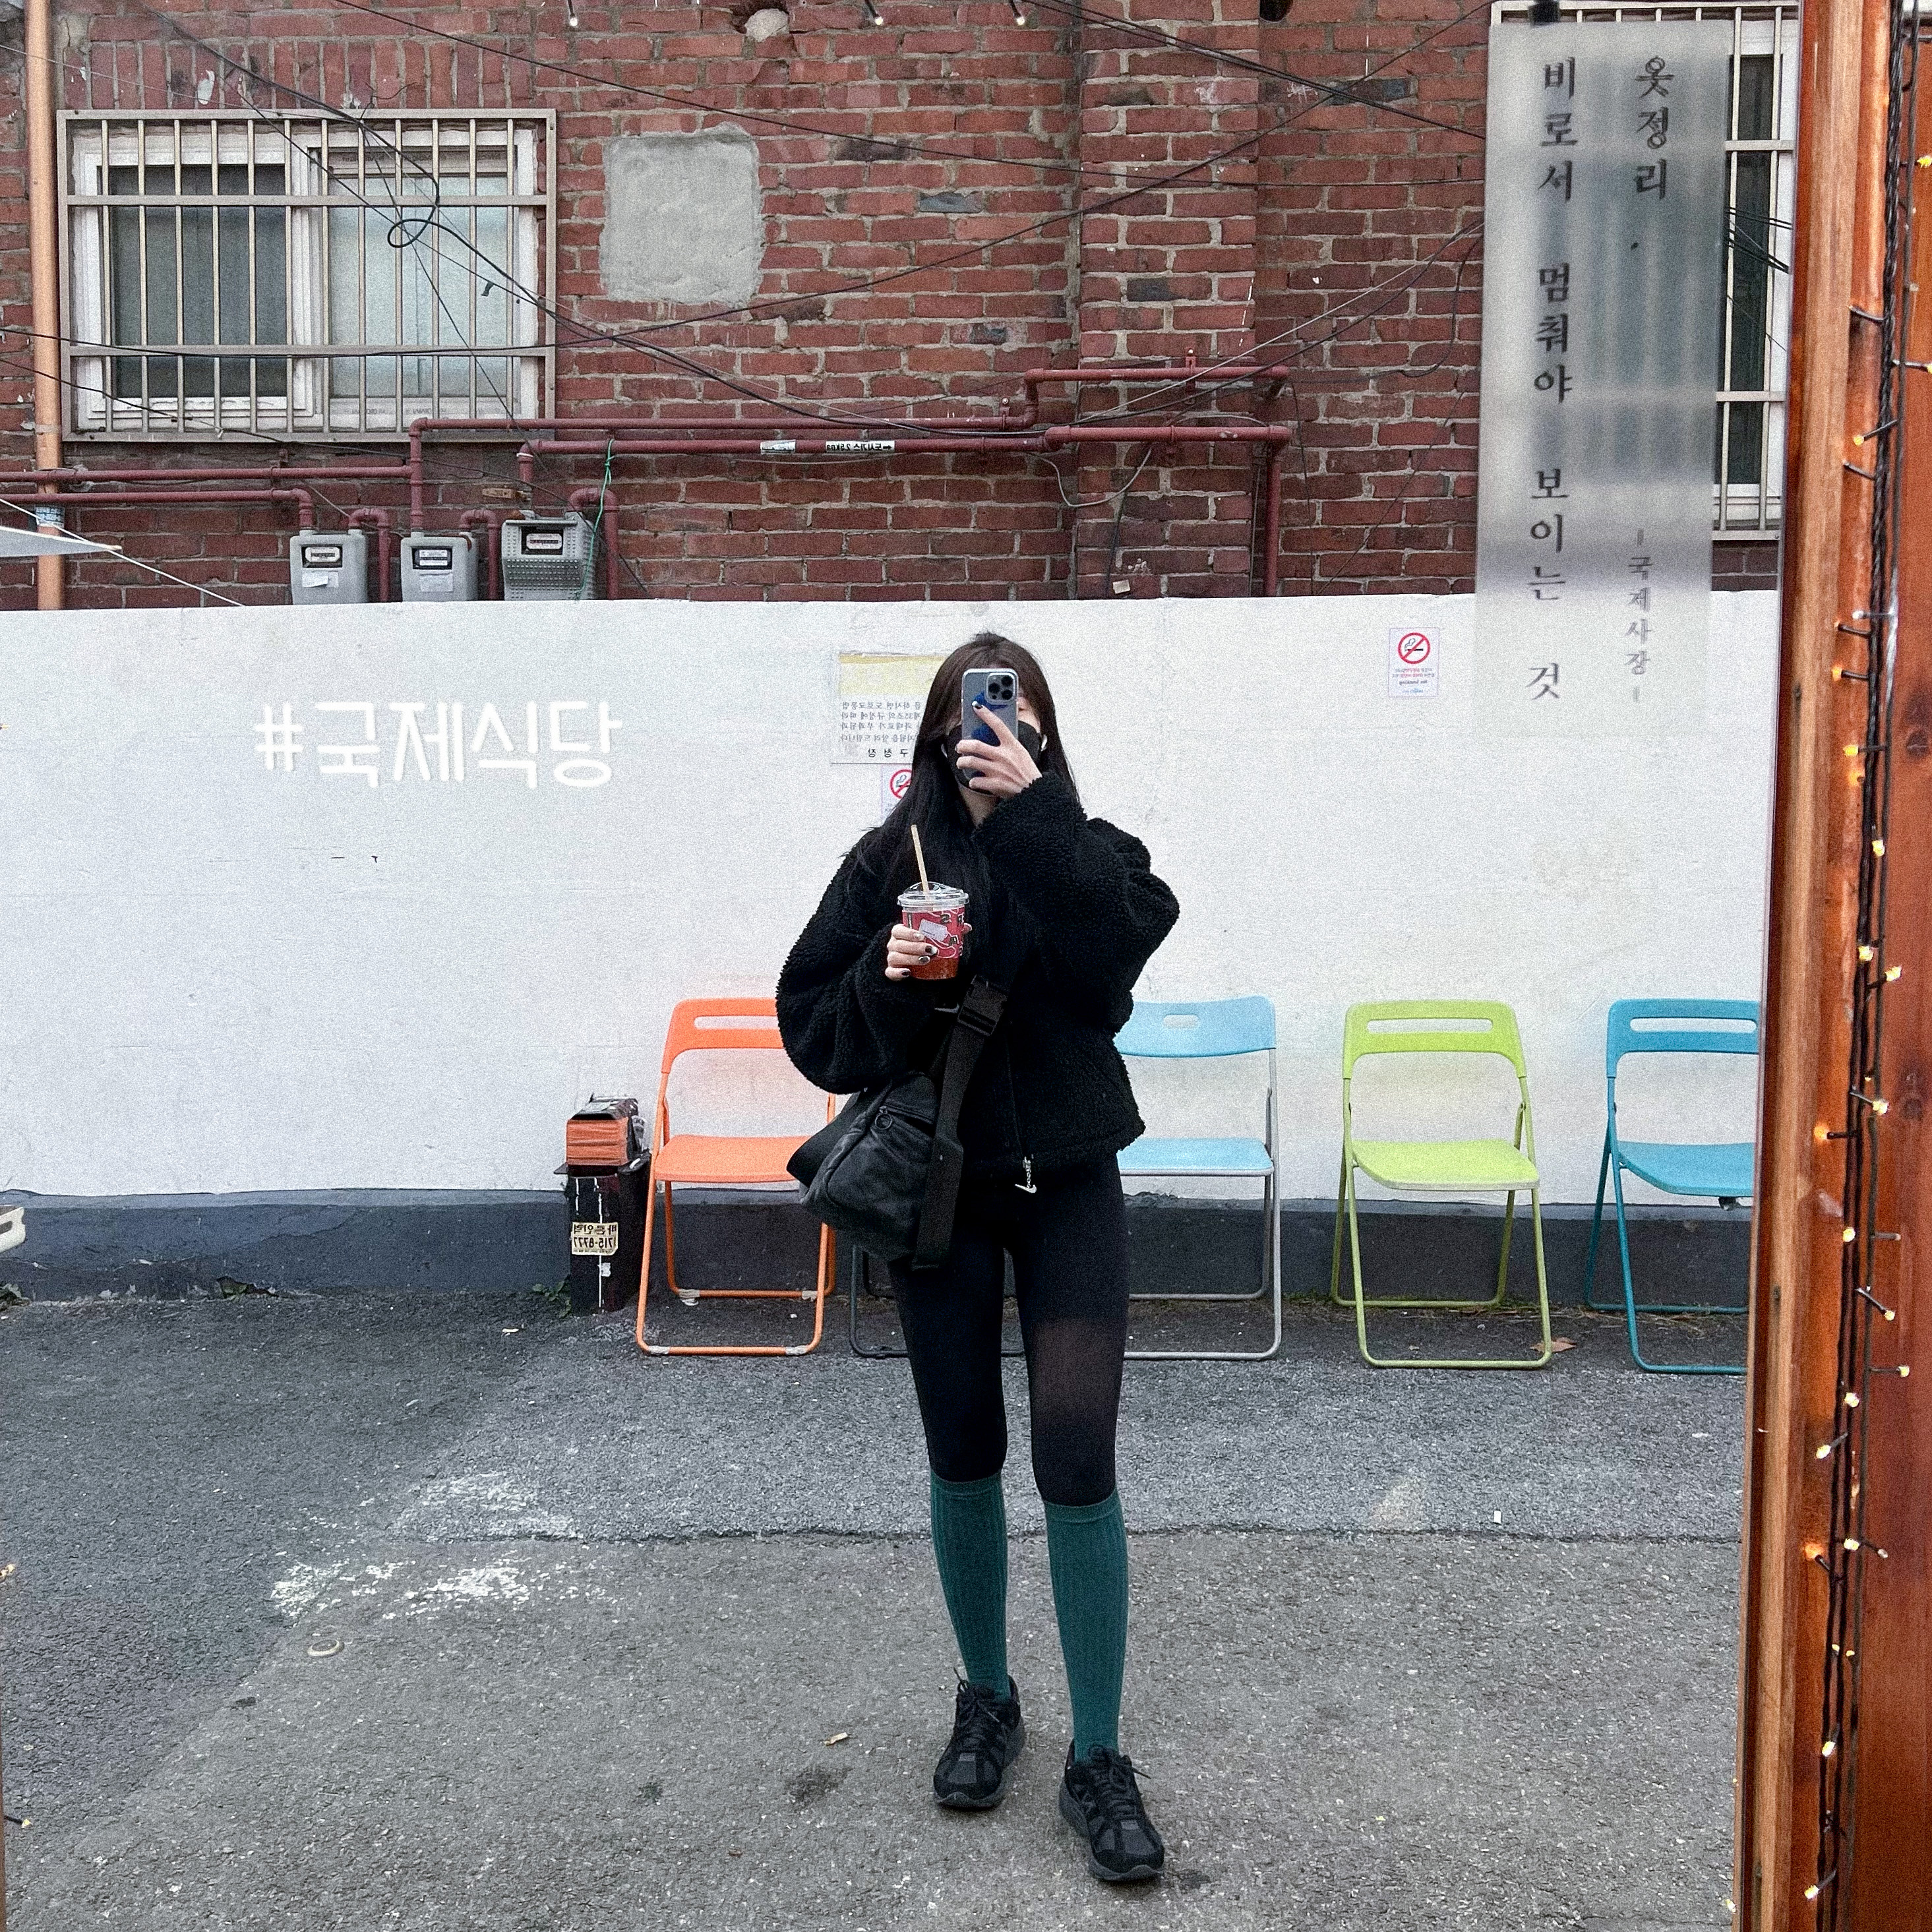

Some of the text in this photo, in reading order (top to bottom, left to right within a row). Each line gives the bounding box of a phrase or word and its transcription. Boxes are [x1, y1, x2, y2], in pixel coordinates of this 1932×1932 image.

[1525, 55, 1579, 701] 비로서 멈춰야 보이는 것
[253, 701, 624, 789] #국제식당
